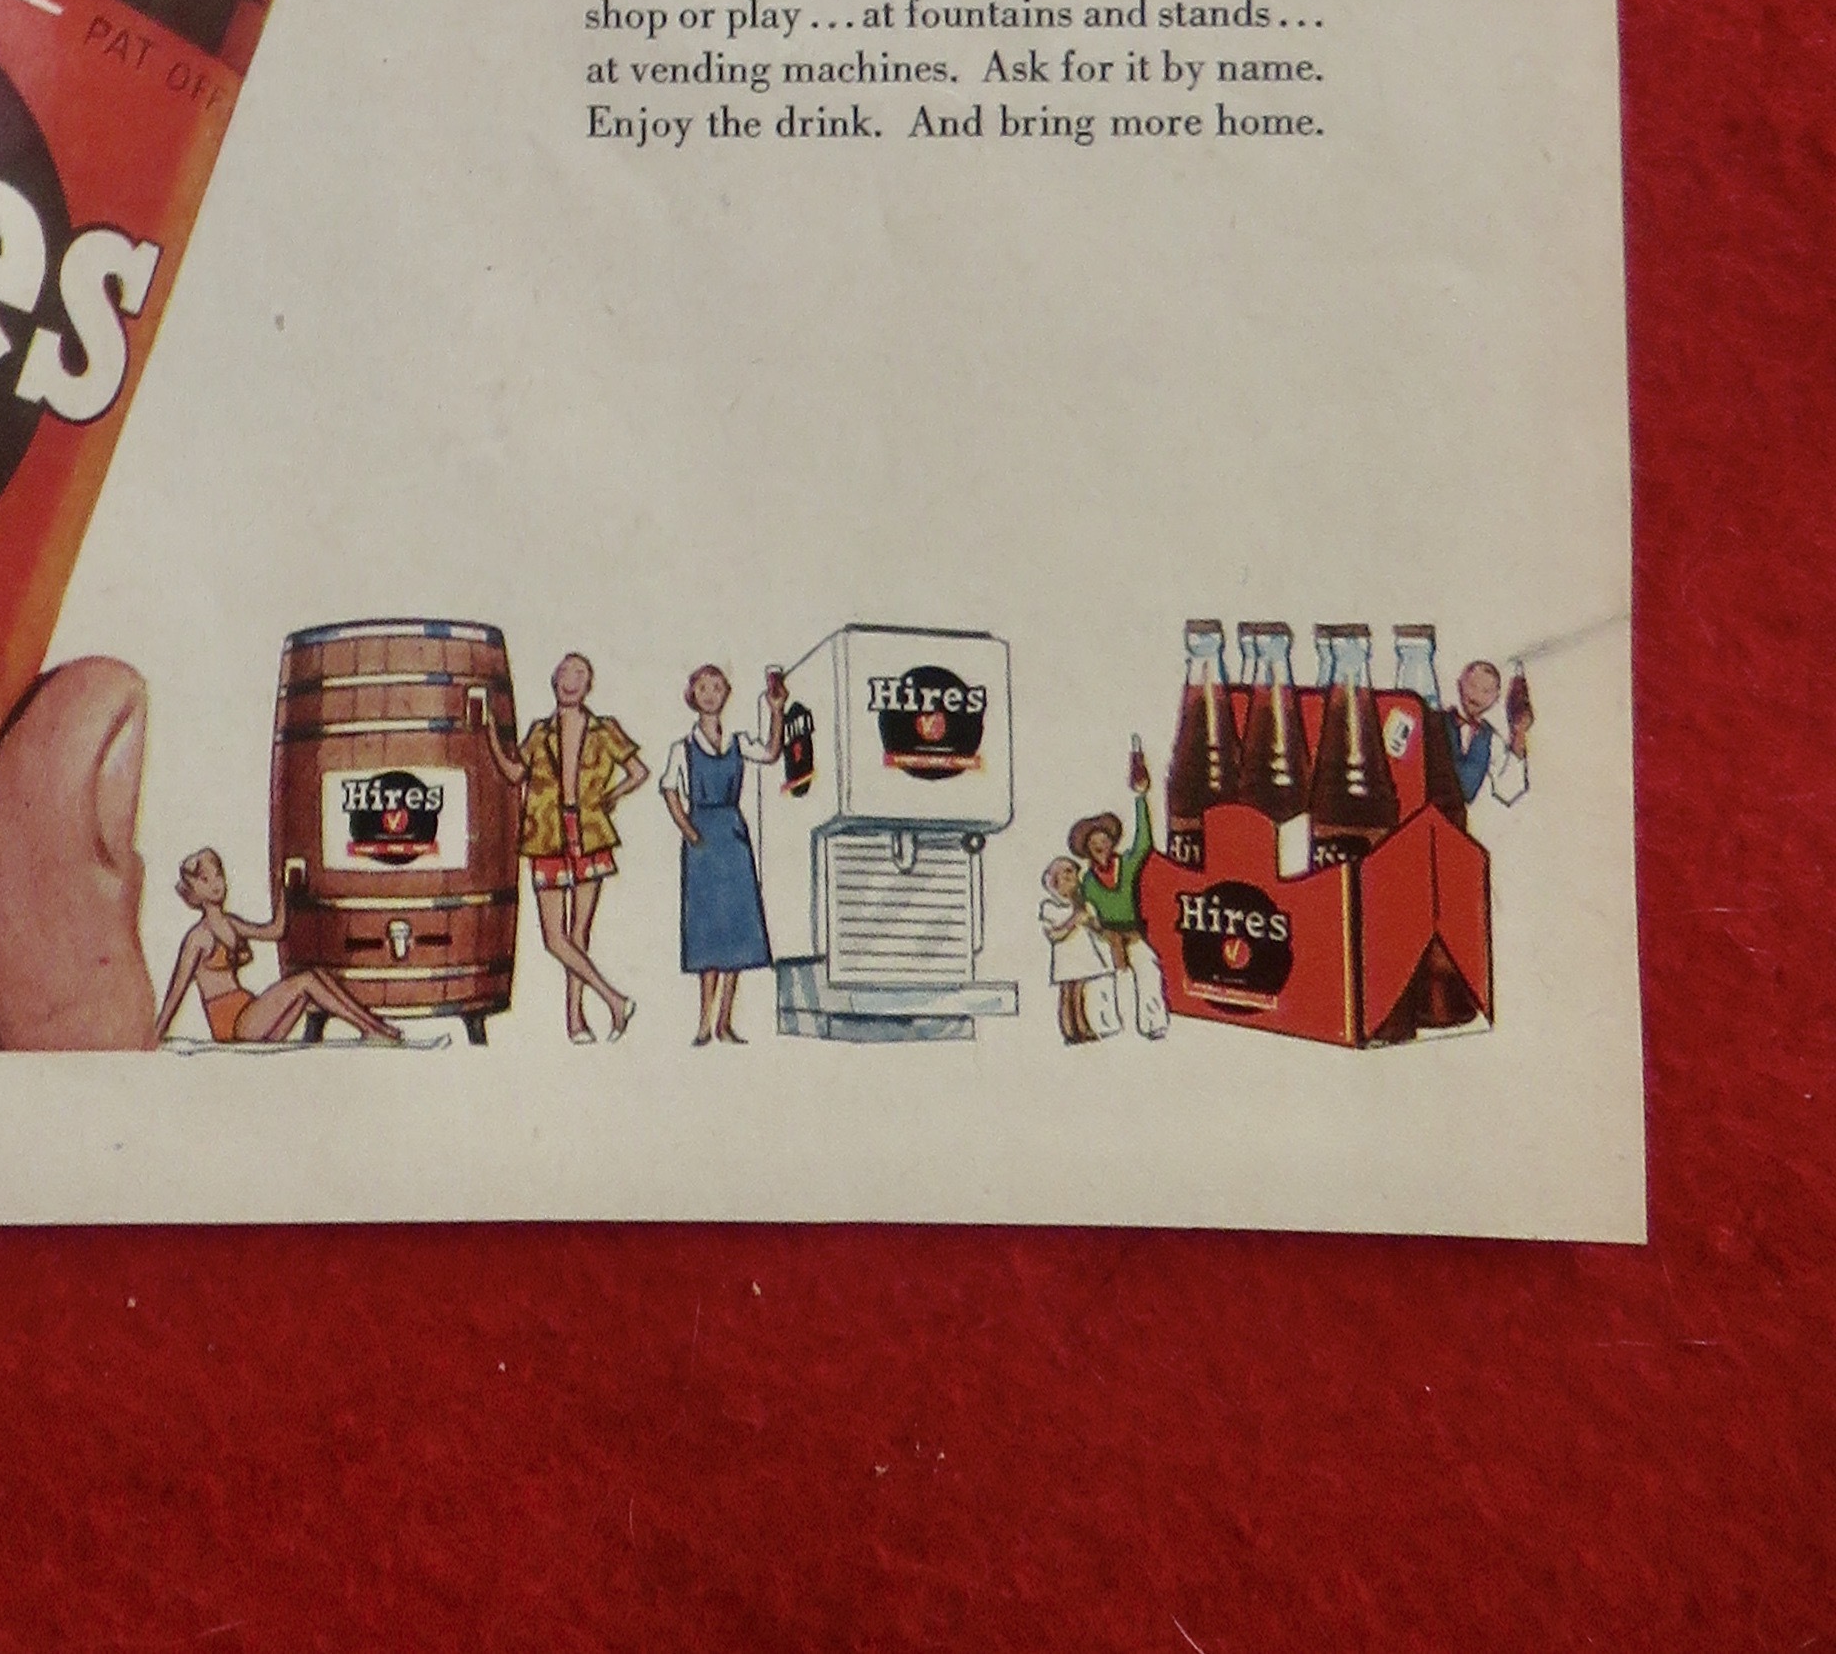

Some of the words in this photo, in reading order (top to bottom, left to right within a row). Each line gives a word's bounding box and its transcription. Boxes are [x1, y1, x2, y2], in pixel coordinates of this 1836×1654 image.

[677, 7, 717, 31] or
[861, 0, 897, 30] at
[83, 13, 155, 70] PAT
[165, 59, 226, 111] OFF
[584, 56, 621, 86] at
[628, 49, 773, 95] vending
[781, 48, 959, 85] machines.
[980, 47, 1052, 84] Ask
[1059, 47, 1116, 84] for
[1125, 49, 1152, 84] it
[1160, 47, 1207, 93] by
[1215, 59, 1325, 83] name.
[585, 103, 695, 150] Enjoy
[705, 102, 763, 140] the
[774, 102, 884, 140] drink.
[906, 102, 985, 139] And
[998, 102, 1097, 148] bring
[1109, 113, 1205, 138] more
[1214, 101, 1325, 138] home.
[868, 676, 984, 713] Hires
[343, 779, 442, 811] Hires
[1179, 894, 1289, 942] Hires
